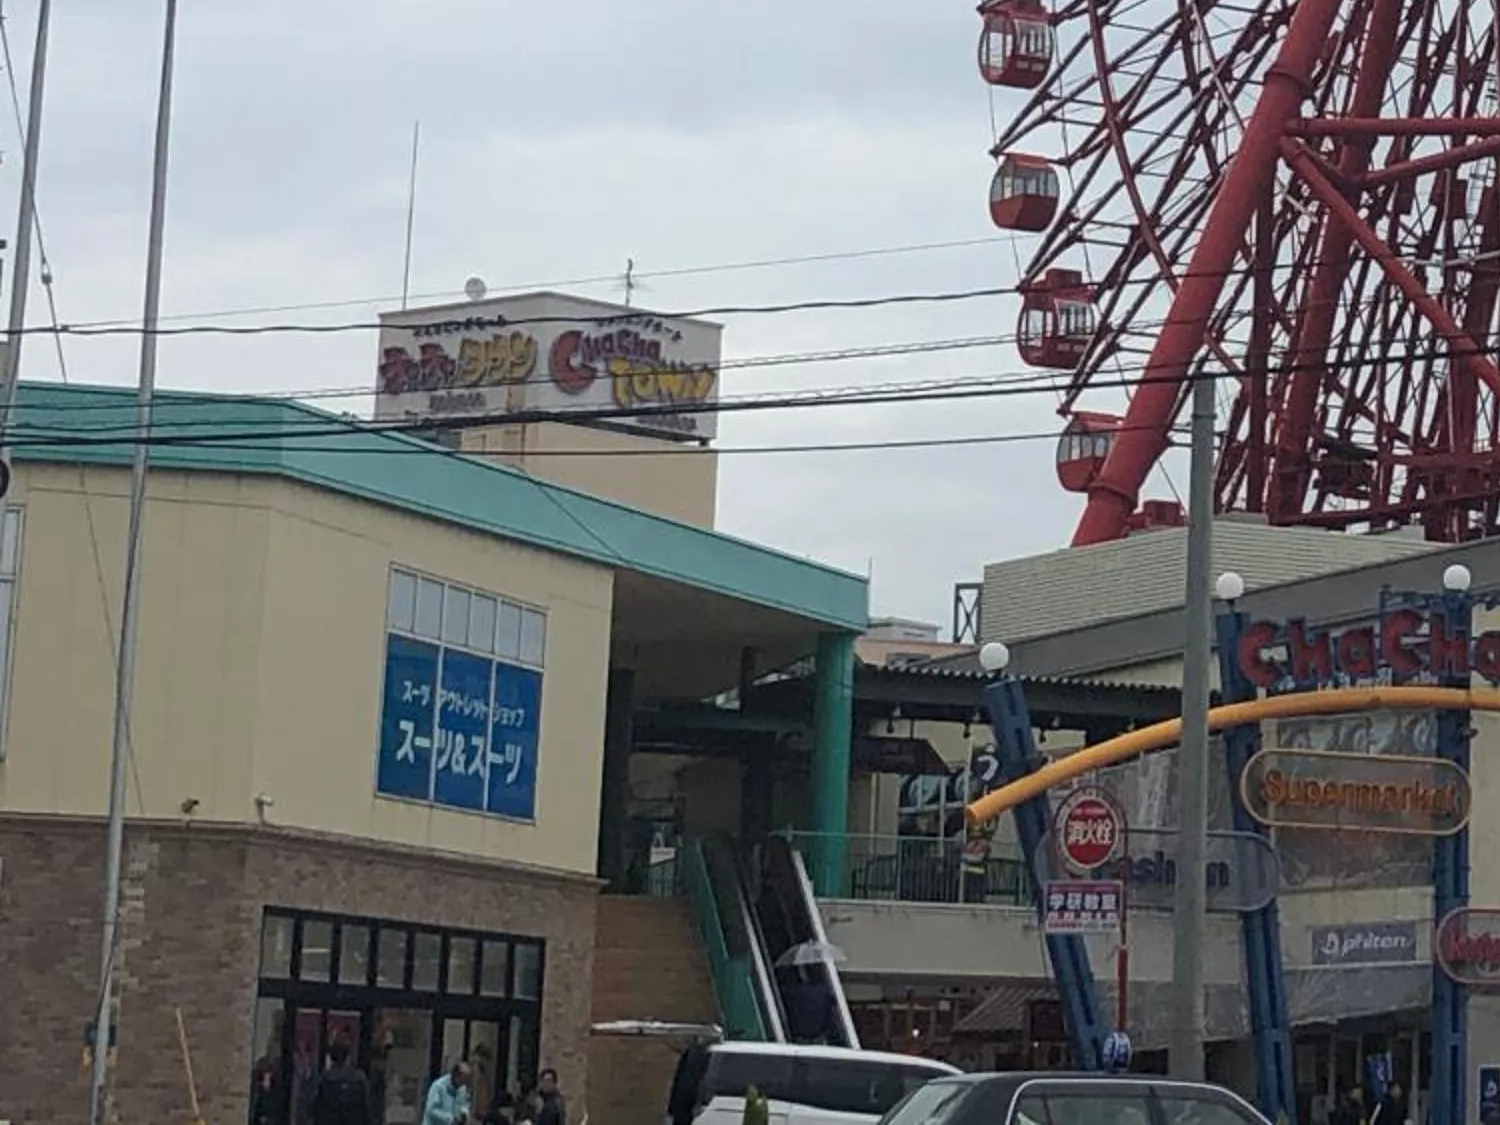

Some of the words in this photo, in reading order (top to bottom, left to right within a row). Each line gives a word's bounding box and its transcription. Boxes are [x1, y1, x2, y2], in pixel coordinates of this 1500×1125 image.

[1261, 768, 1457, 813] Supermarket
[1067, 818, 1114, 845] 消火栓
